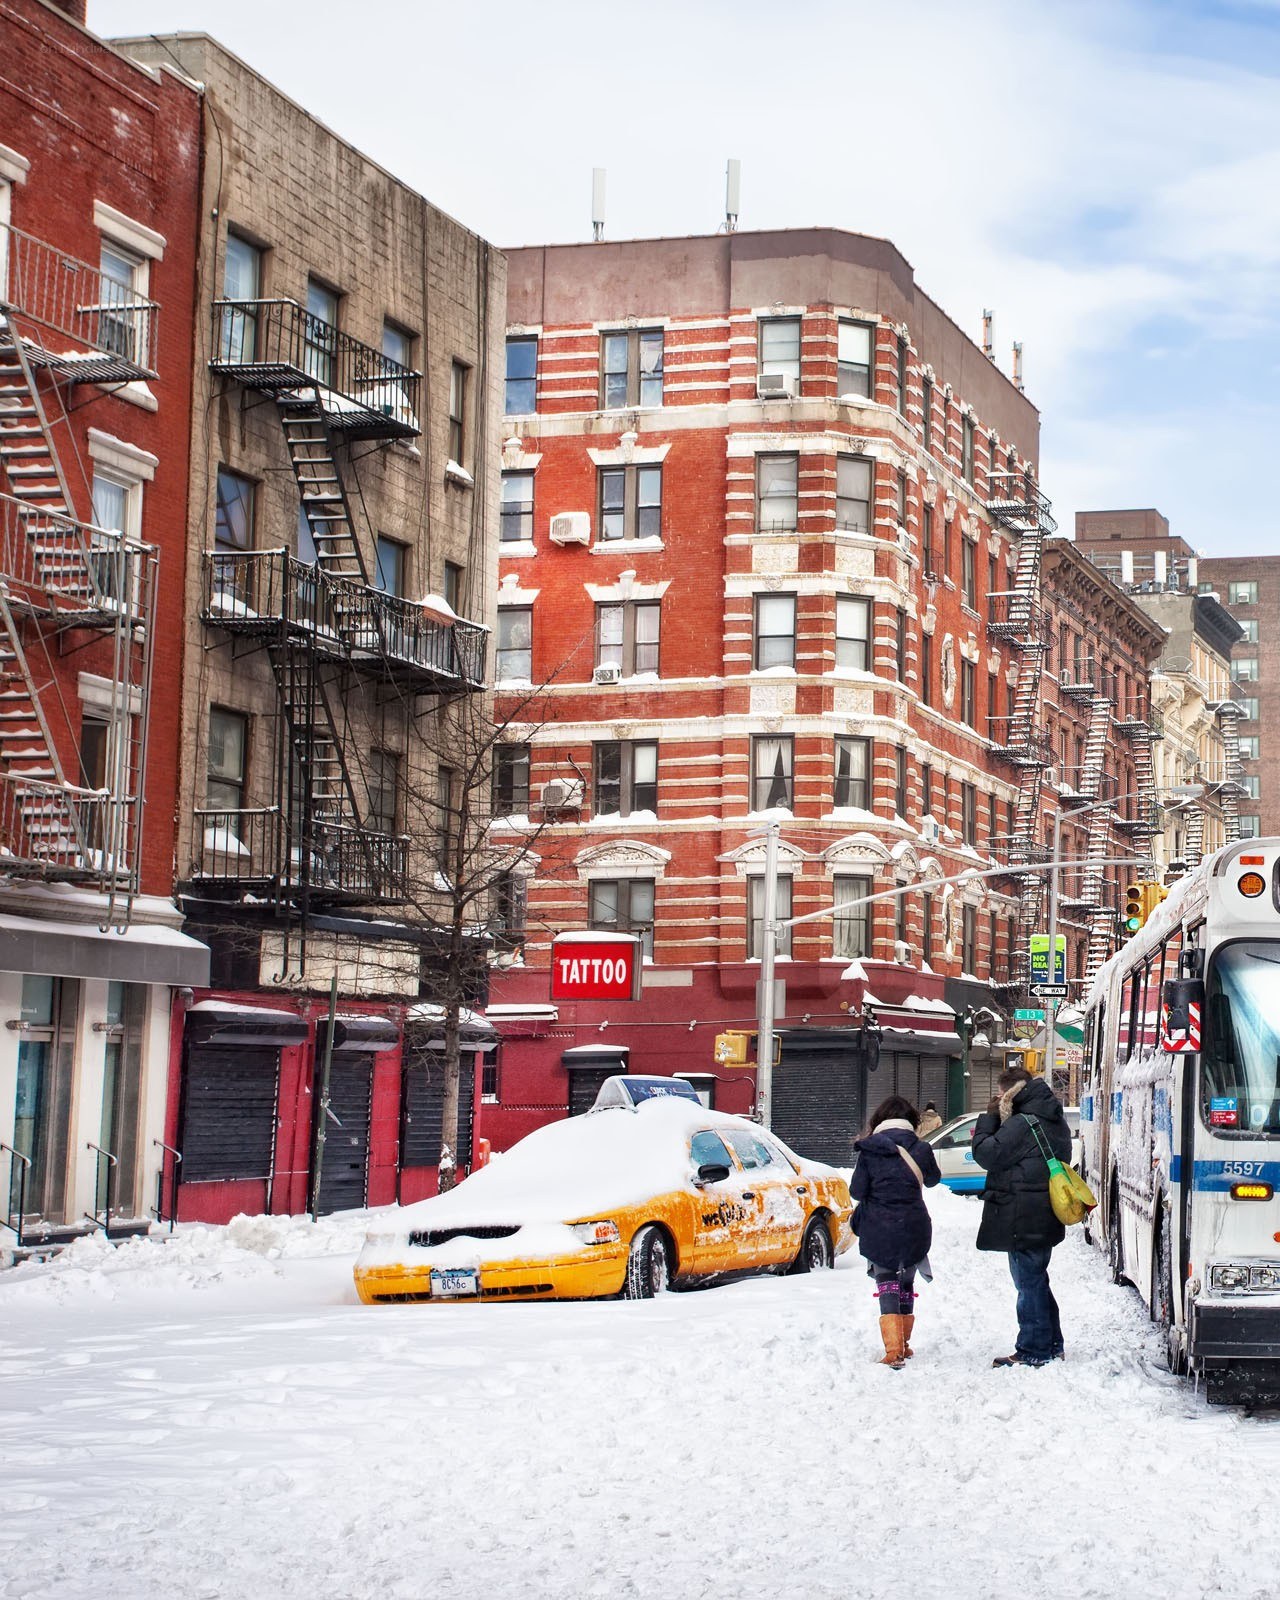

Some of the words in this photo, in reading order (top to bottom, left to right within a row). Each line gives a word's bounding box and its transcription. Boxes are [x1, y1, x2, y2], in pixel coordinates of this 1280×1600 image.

[560, 958, 627, 984] TATTOO
[1016, 1010, 1022, 1019] E
[1026, 1010, 1036, 1019] 13
[1223, 1161, 1265, 1176] 5597
